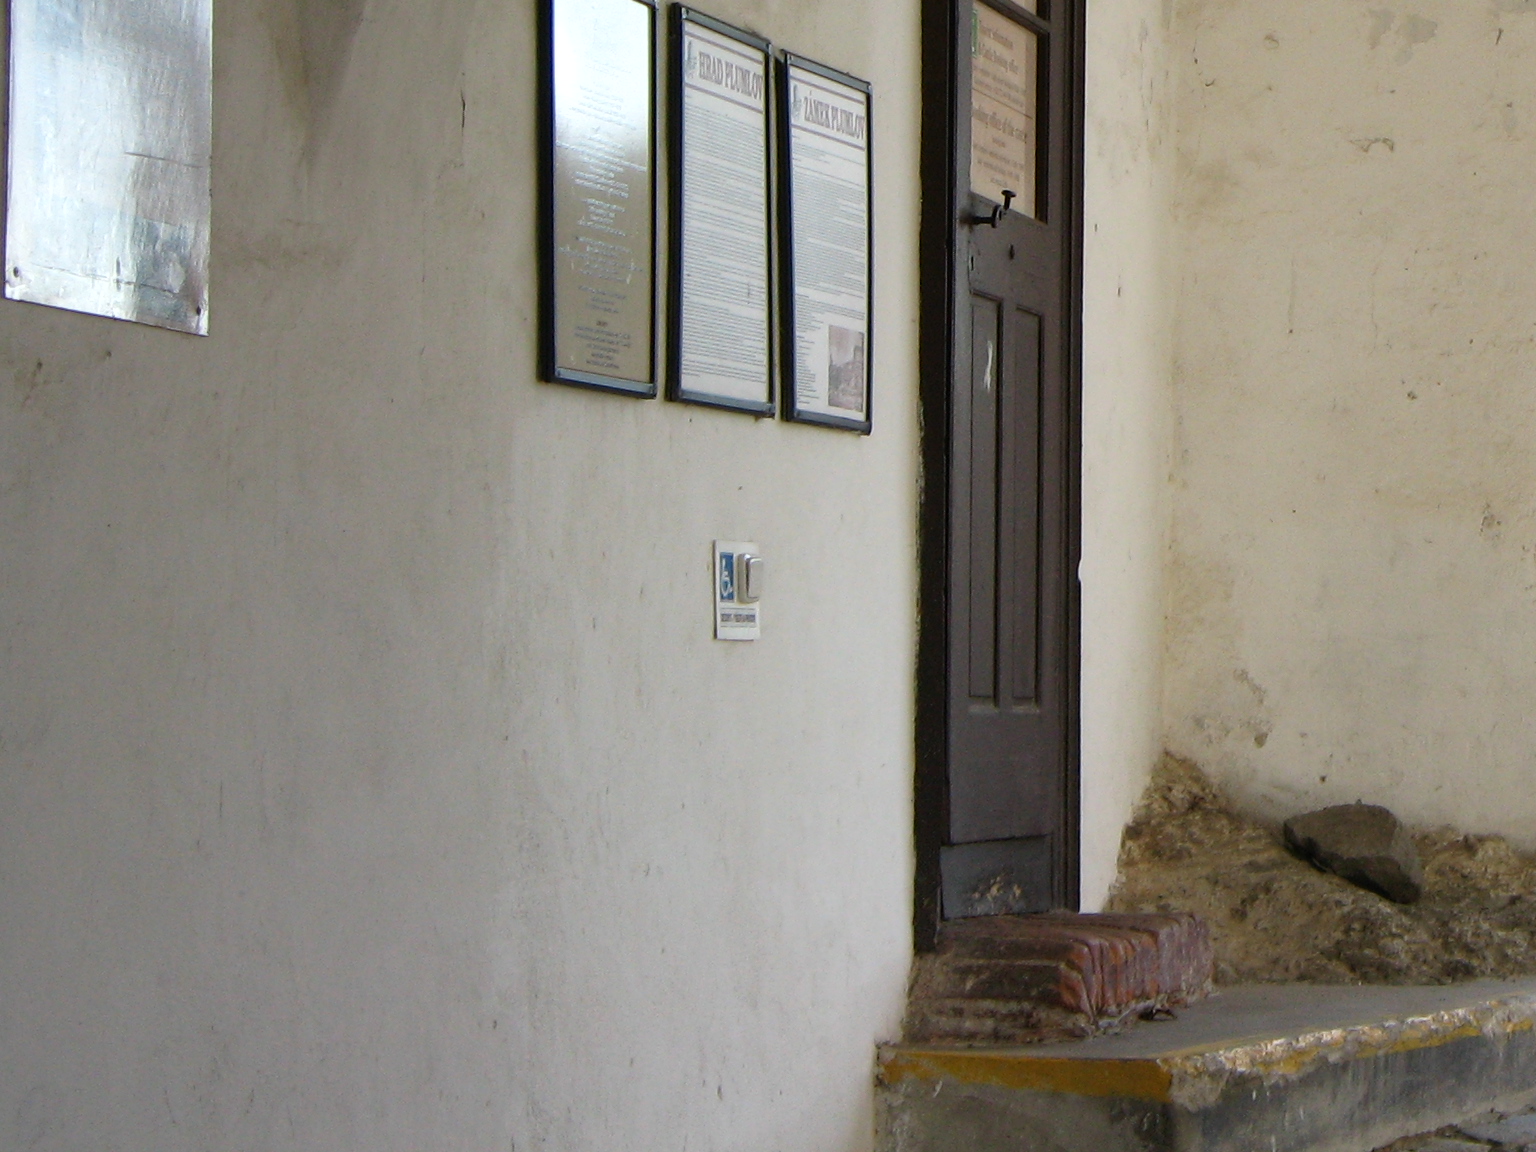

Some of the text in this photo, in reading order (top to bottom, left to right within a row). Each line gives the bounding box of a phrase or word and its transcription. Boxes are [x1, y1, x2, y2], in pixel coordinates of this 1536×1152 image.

[699, 51, 763, 100] HRAD PLUMLOV
[804, 90, 831, 129] ZÁMEK
